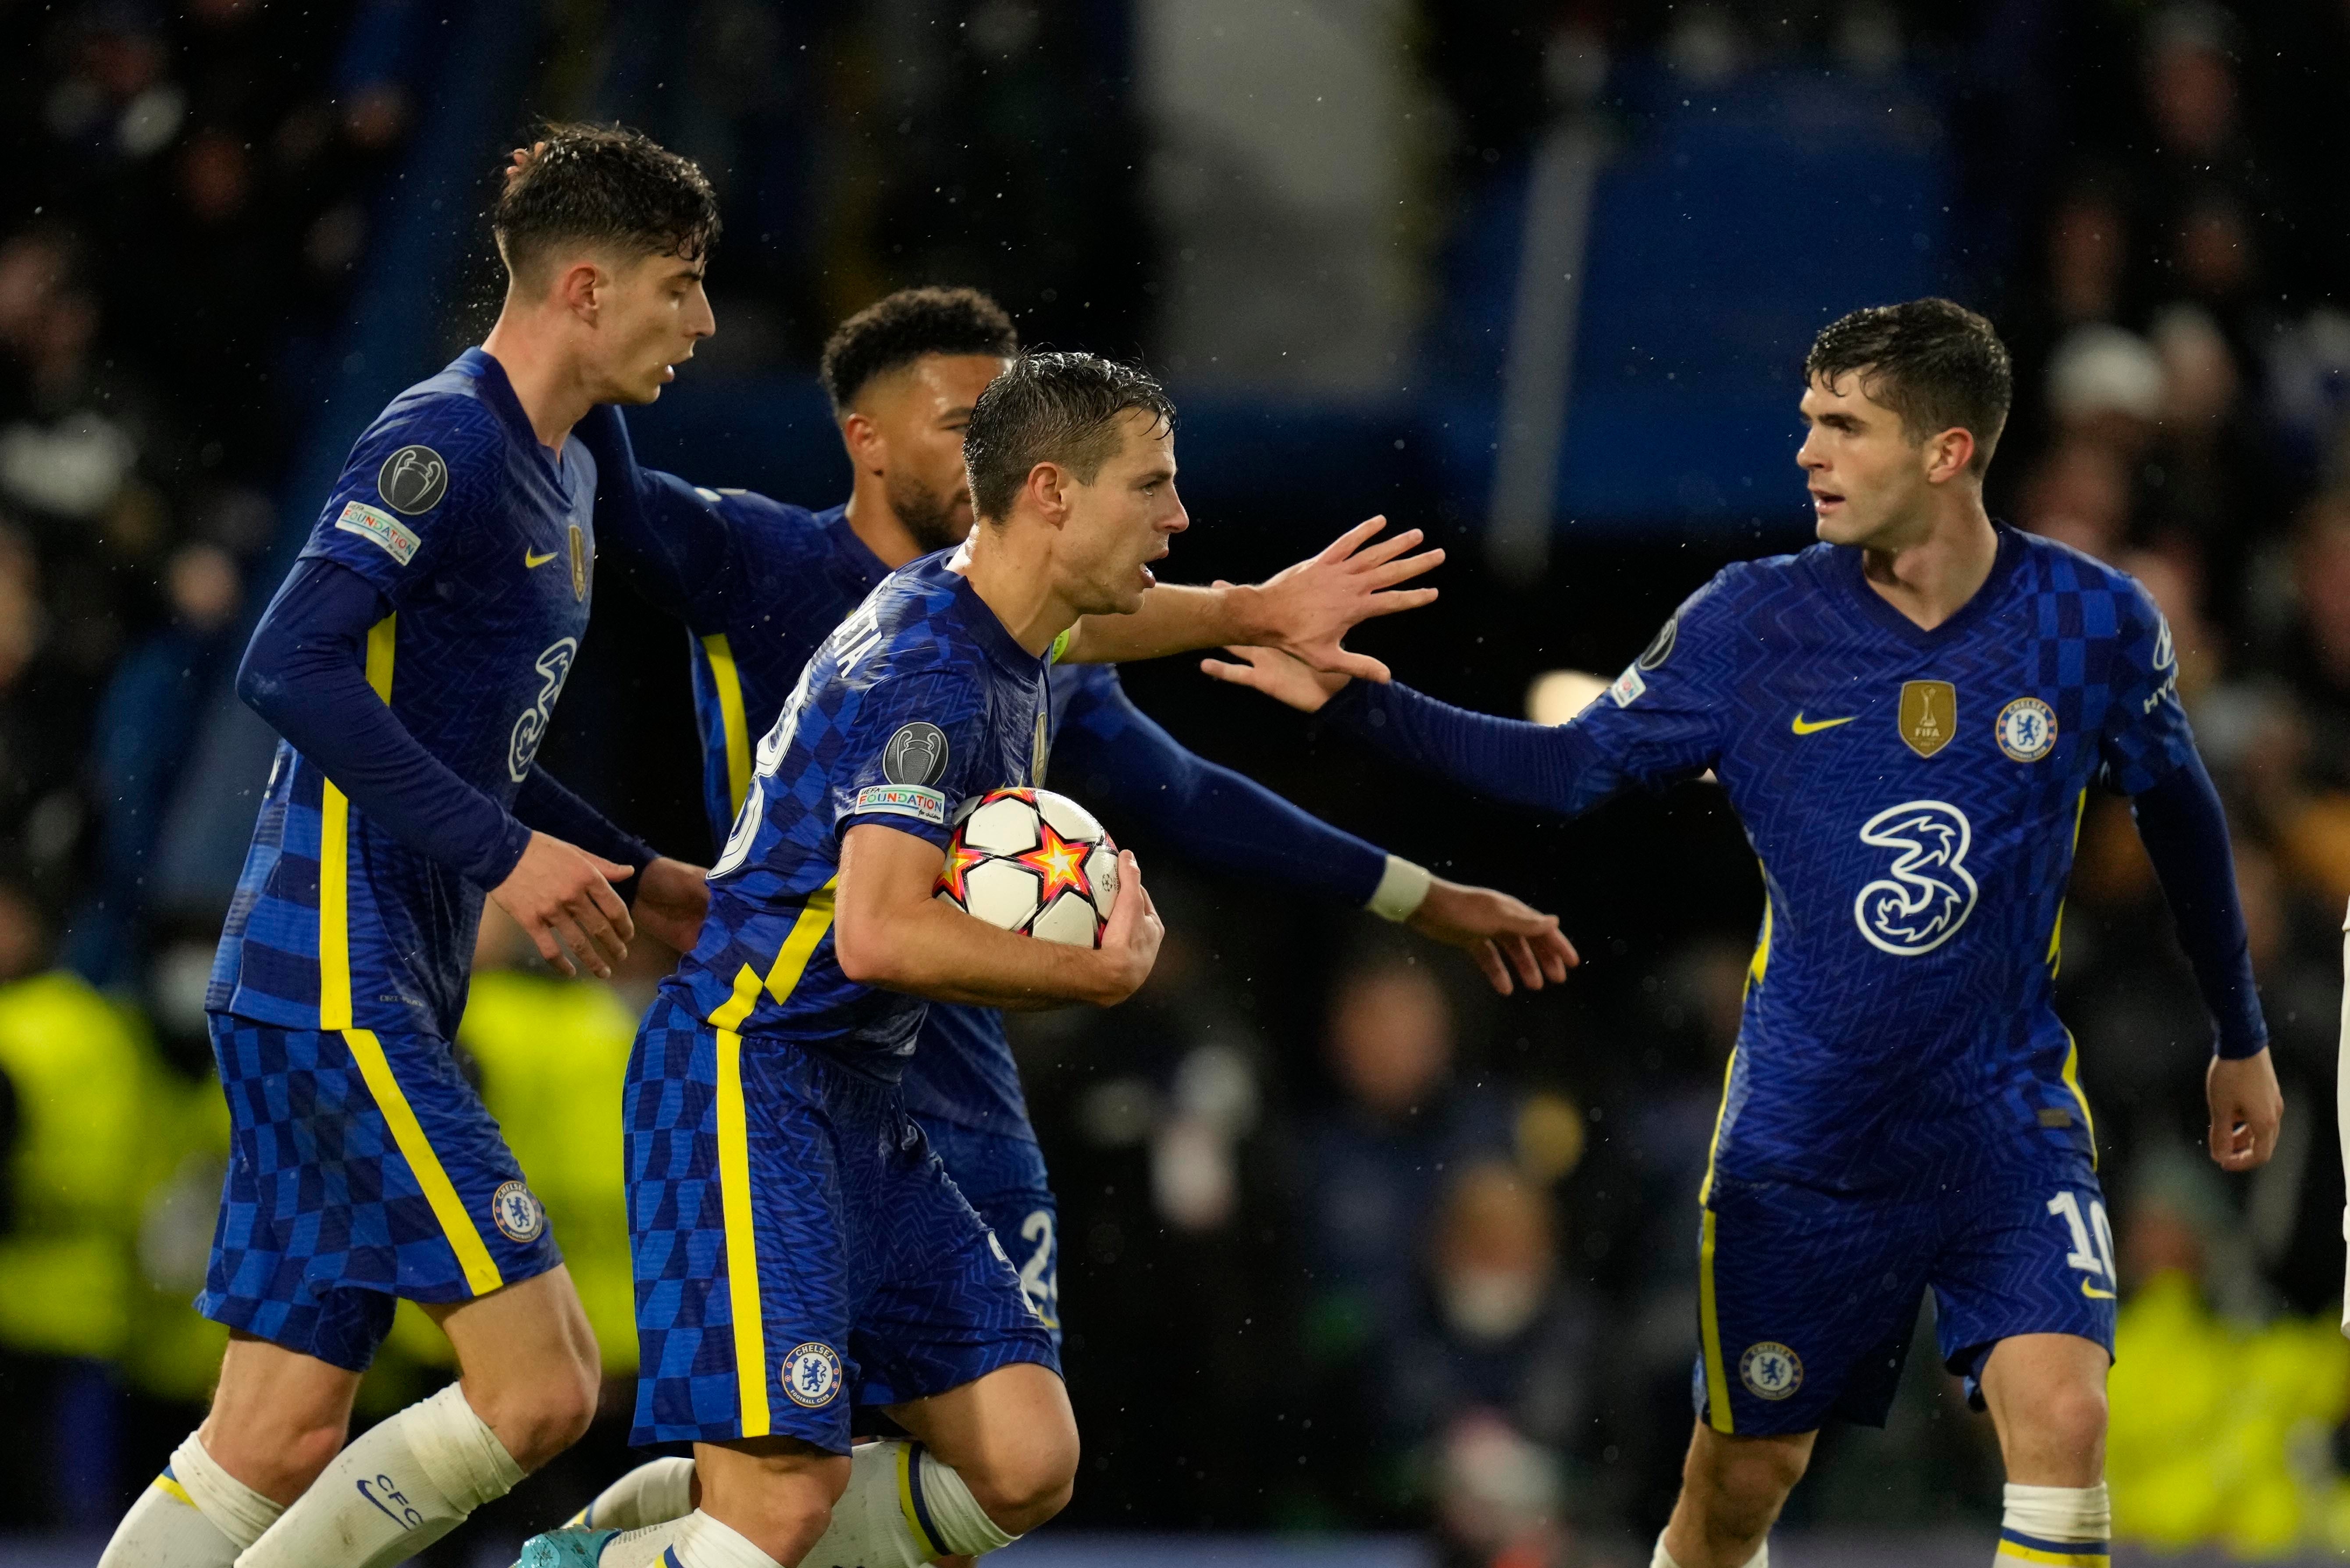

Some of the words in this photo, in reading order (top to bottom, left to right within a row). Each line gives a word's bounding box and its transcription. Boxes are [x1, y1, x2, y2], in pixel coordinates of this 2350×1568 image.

[342, 508, 415, 556] FOUNDATION
[861, 787, 881, 796] UEFA
[859, 793, 942, 813] FOUNDATION
[926, 811, 942, 821] children
[1855, 800, 1979, 956] 3
[497, 1183, 527, 1200] CHELSEA
[2046, 1191, 2117, 1289] 10
[795, 1345, 834, 1362] CHELSEA
[790, 1389, 815, 1404] FOOTBALL
[816, 1393, 830, 1404] CLUB
[376, 1474, 424, 1528] CFC
